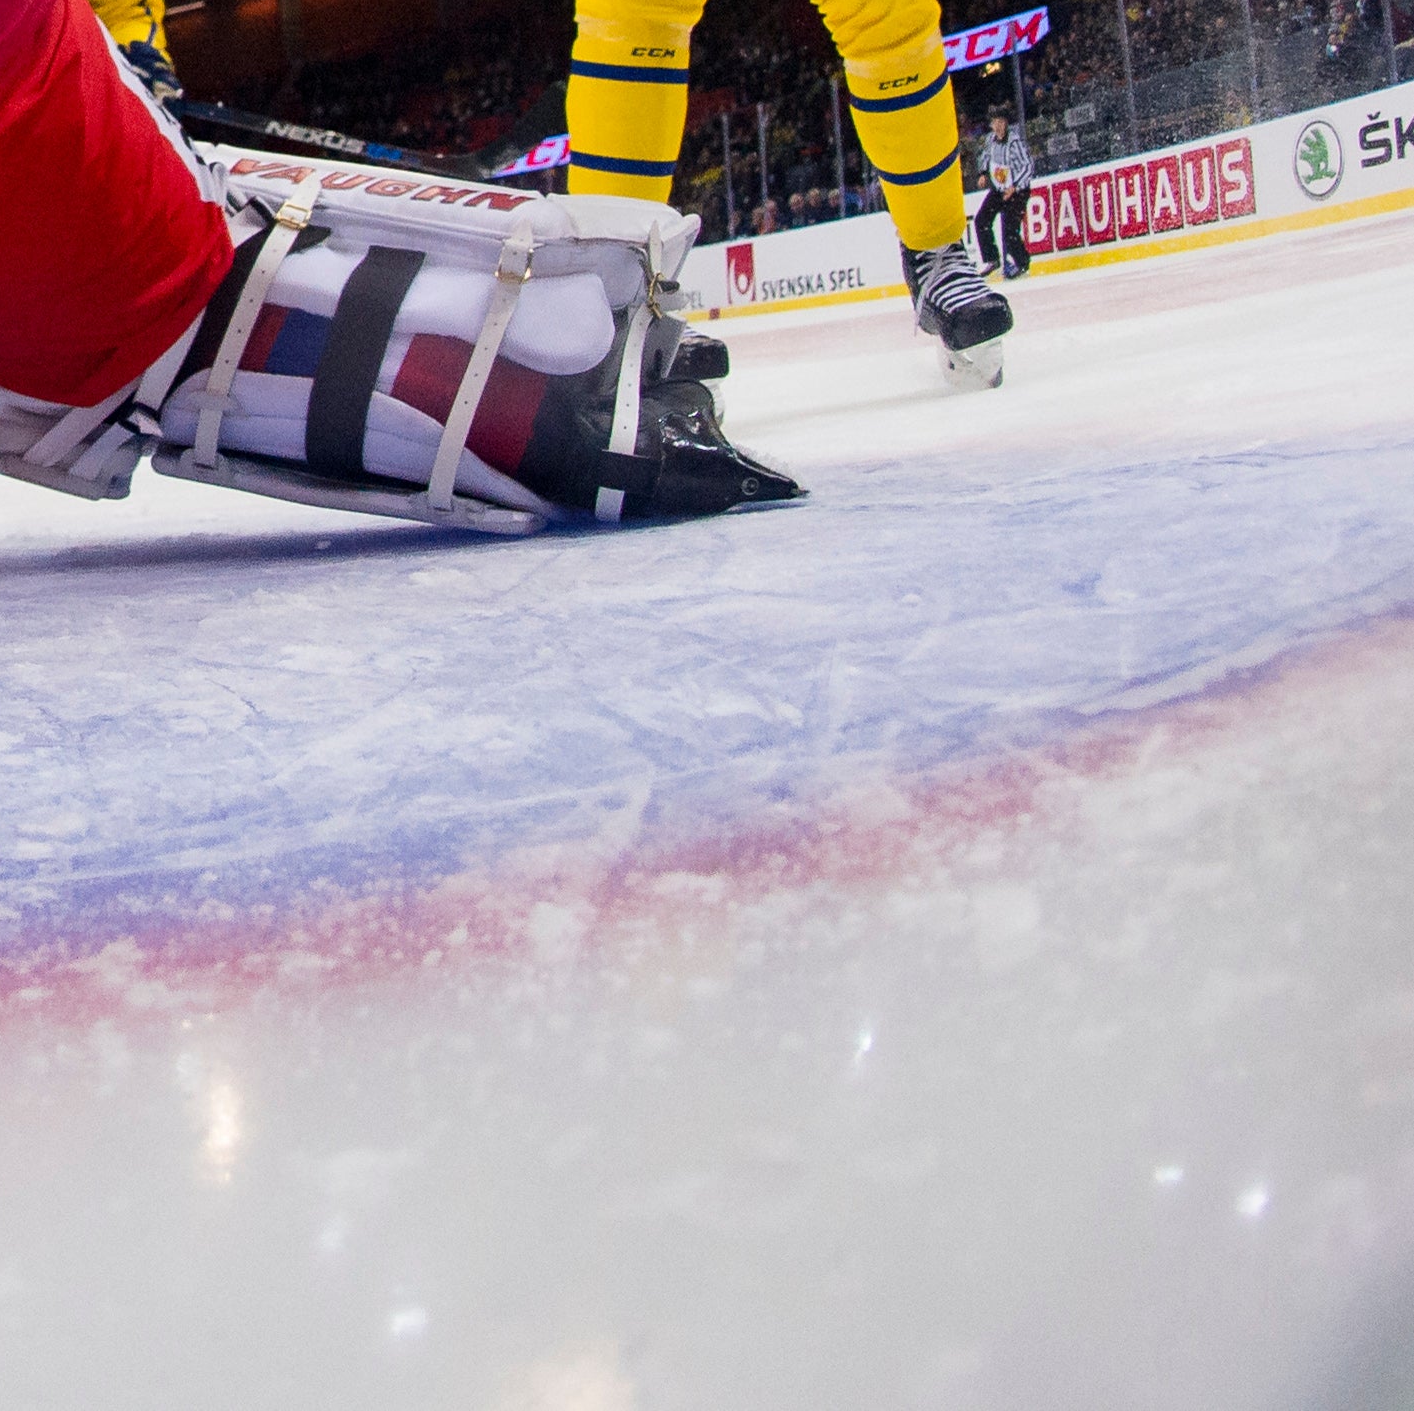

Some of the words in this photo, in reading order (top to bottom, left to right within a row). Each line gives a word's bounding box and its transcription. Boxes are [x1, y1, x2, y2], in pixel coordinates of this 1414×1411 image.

[630, 47, 675, 58] CCM
[877, 73, 919, 91] CCM
[229, 157, 538, 213] VAUGHN
[1026, 148, 1251, 244] BAUHAUS
[761, 273, 824, 302] SVENSKA
[829, 266, 865, 291] SPEL
